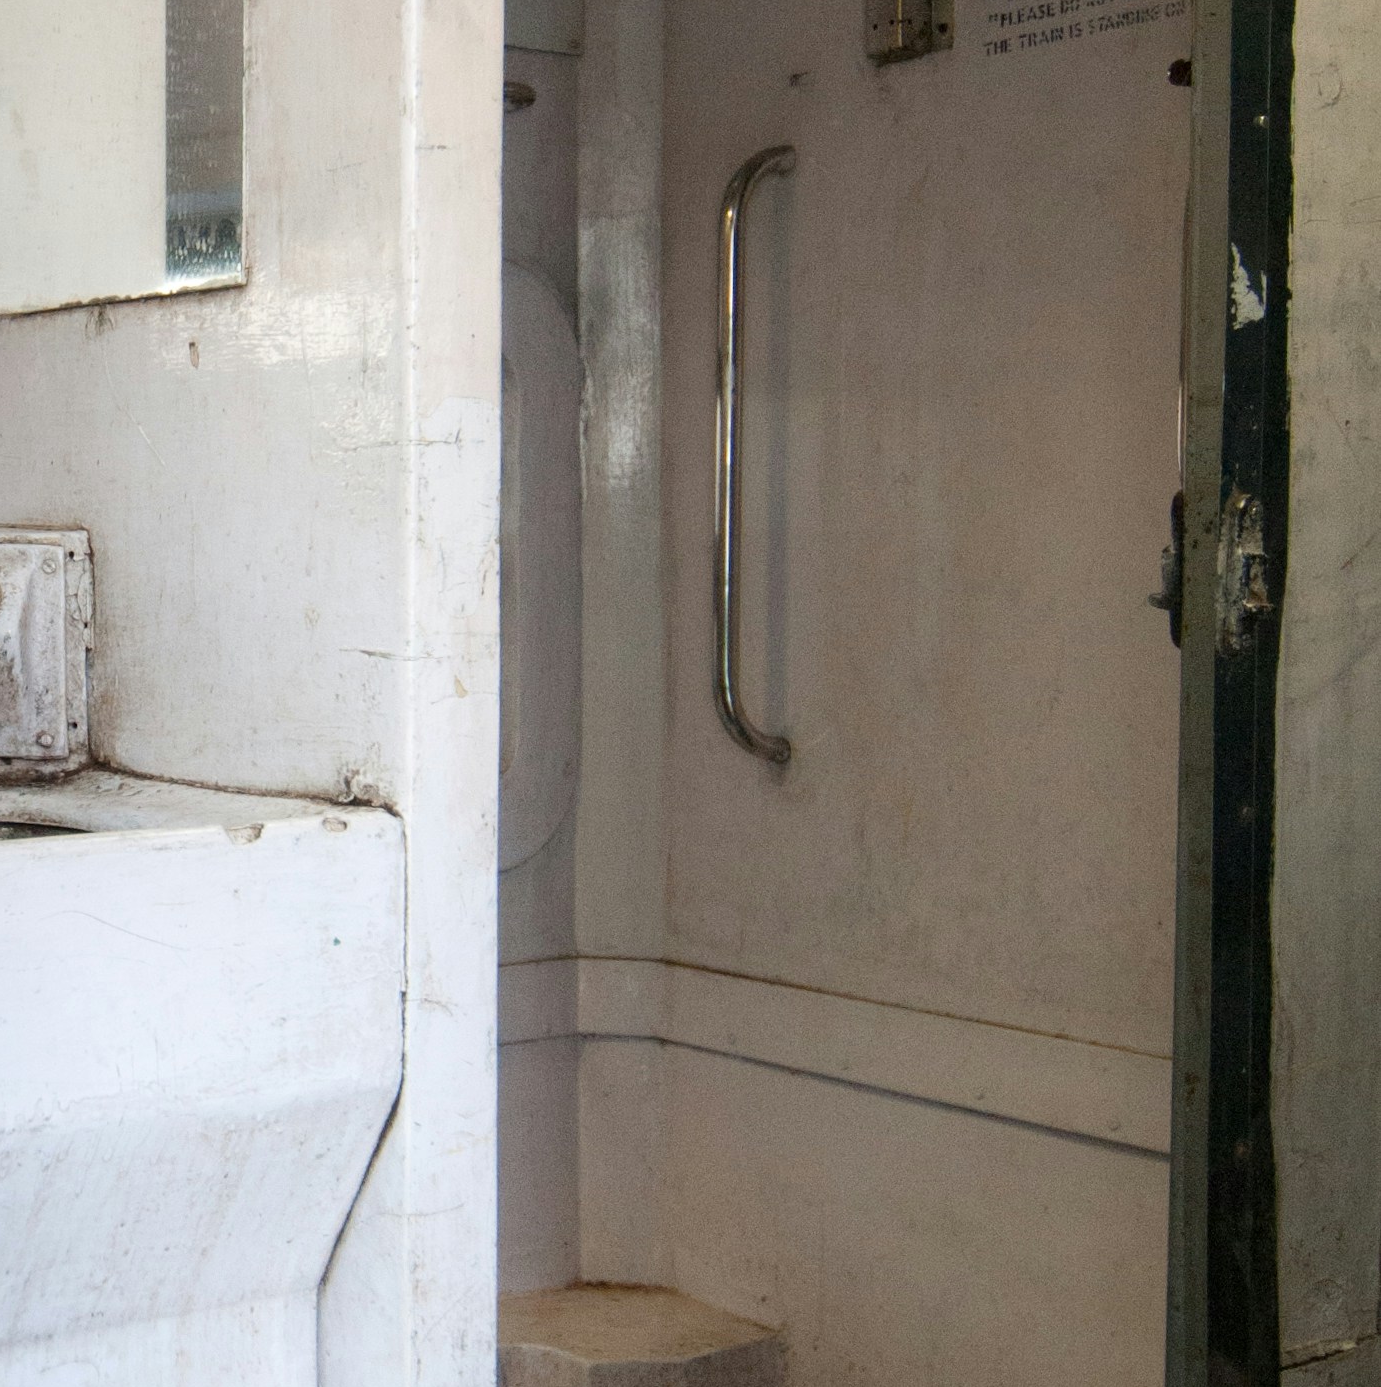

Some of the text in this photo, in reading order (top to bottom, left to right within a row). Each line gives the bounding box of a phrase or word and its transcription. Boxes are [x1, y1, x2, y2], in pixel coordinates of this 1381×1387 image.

[982, 38, 1013, 57] THE
[1018, 26, 1065, 52] TRAIN
[1068, 21, 1084, 39] IS
[1087, 4, 1161, 36] STANDING
[1164, 0, 1187, 19] ON
